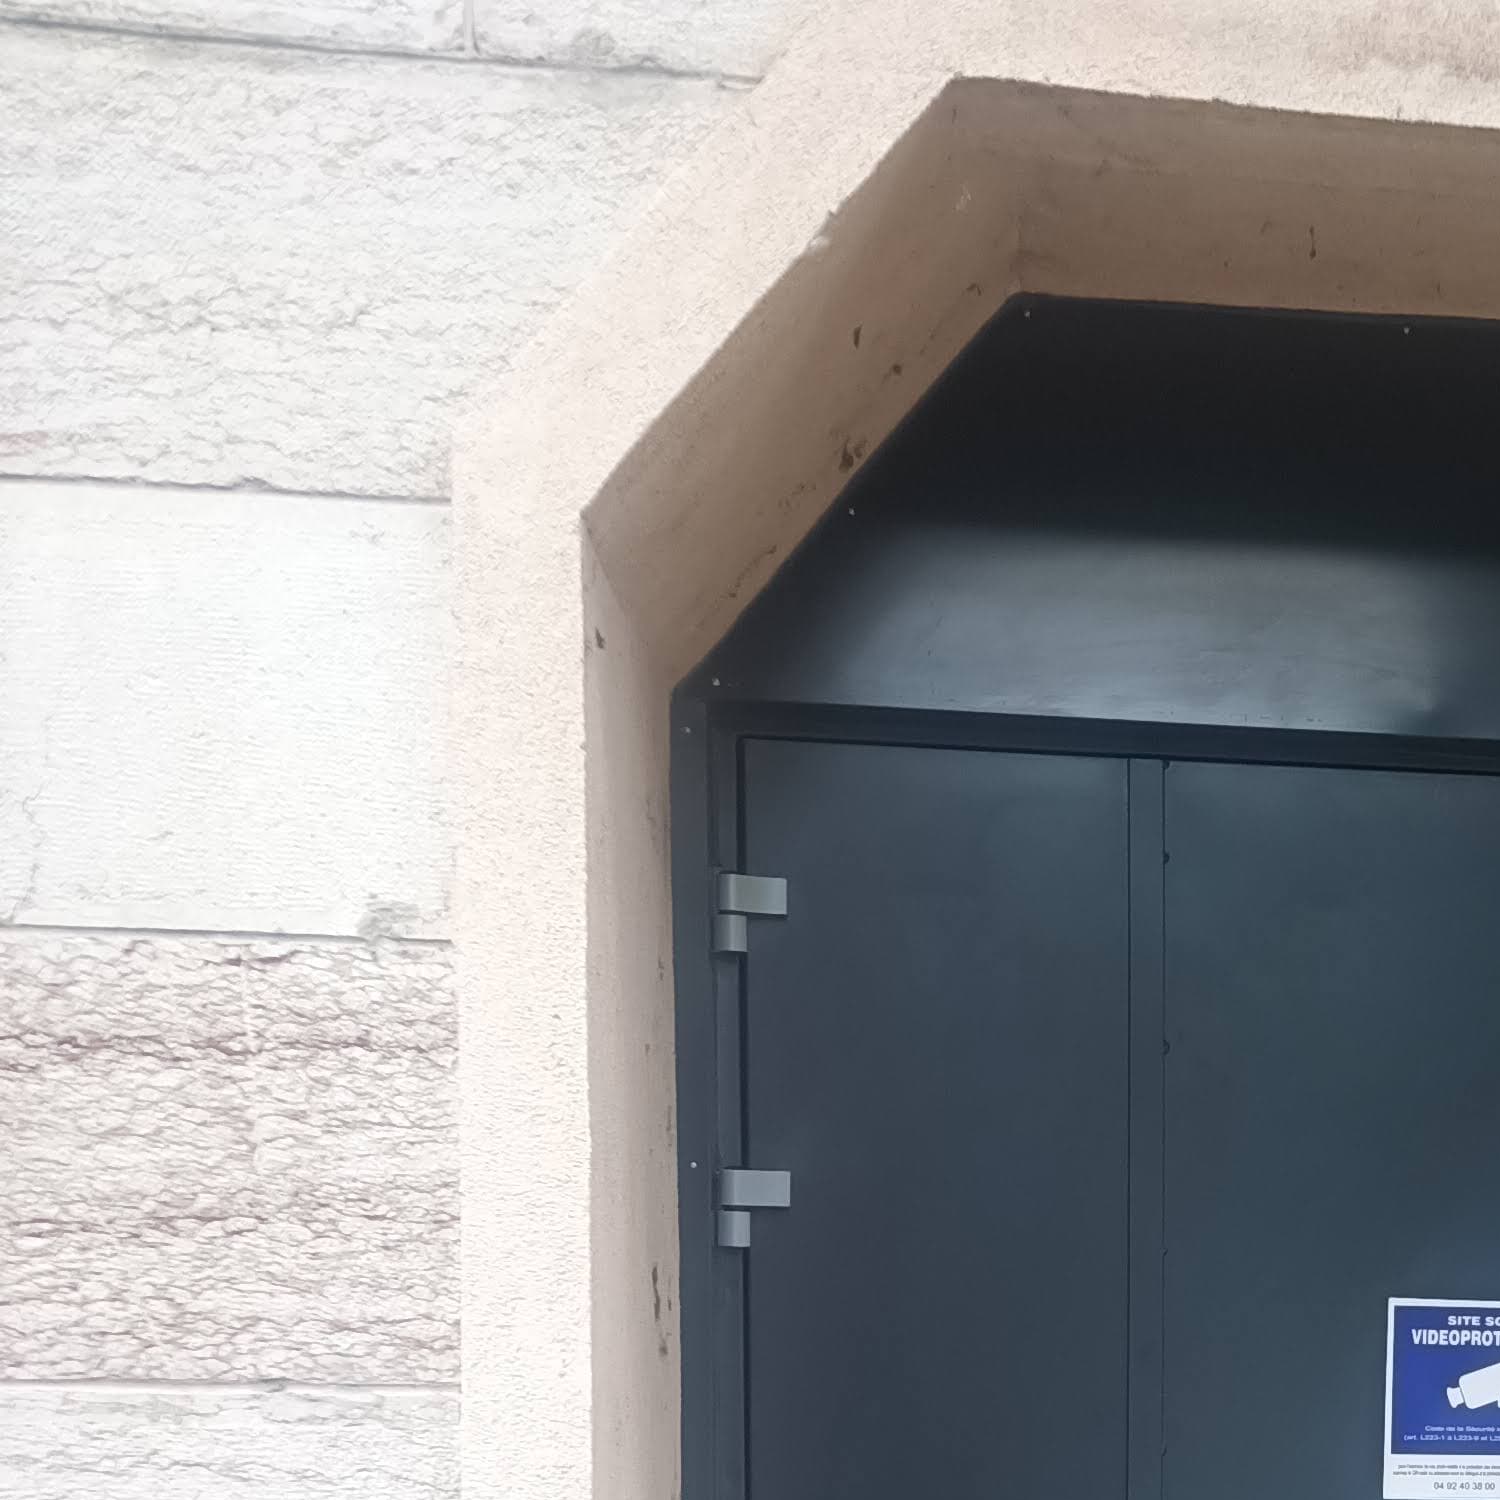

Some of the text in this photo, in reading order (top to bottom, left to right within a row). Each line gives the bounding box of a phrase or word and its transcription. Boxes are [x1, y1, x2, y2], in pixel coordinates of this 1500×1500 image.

[1447, 1316, 1481, 1326] SITE
[1433, 1481, 1444, 1490] 04
[1459, 1482, 1470, 1490] 40
[1484, 1482, 1496, 1490] 00
